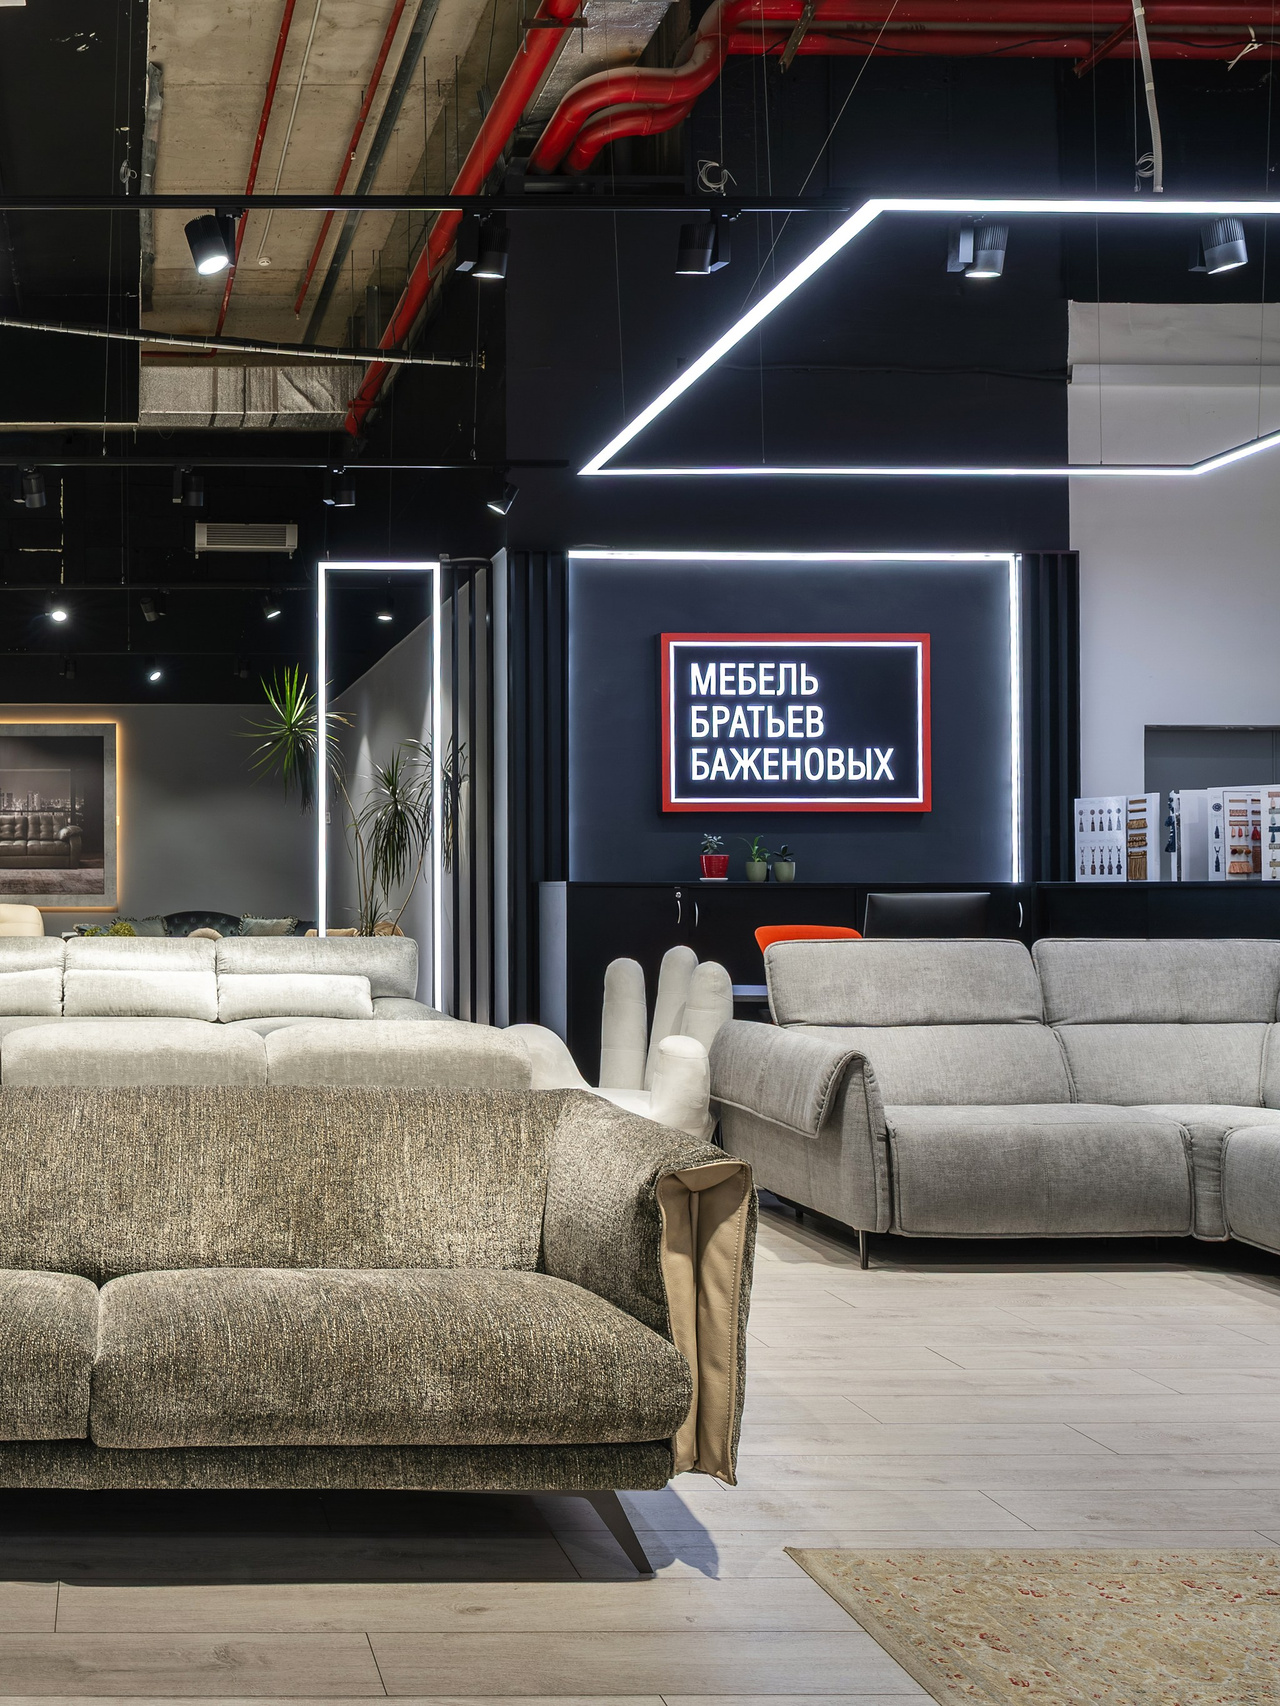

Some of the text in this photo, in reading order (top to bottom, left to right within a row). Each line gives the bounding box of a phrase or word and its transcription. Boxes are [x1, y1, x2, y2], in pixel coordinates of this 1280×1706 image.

[690, 662, 819, 695] МЕБЕЛЬ
[690, 705, 825, 738] БРАТЬЕВ
[691, 747, 895, 781] БАЖЕНОВЫХ
